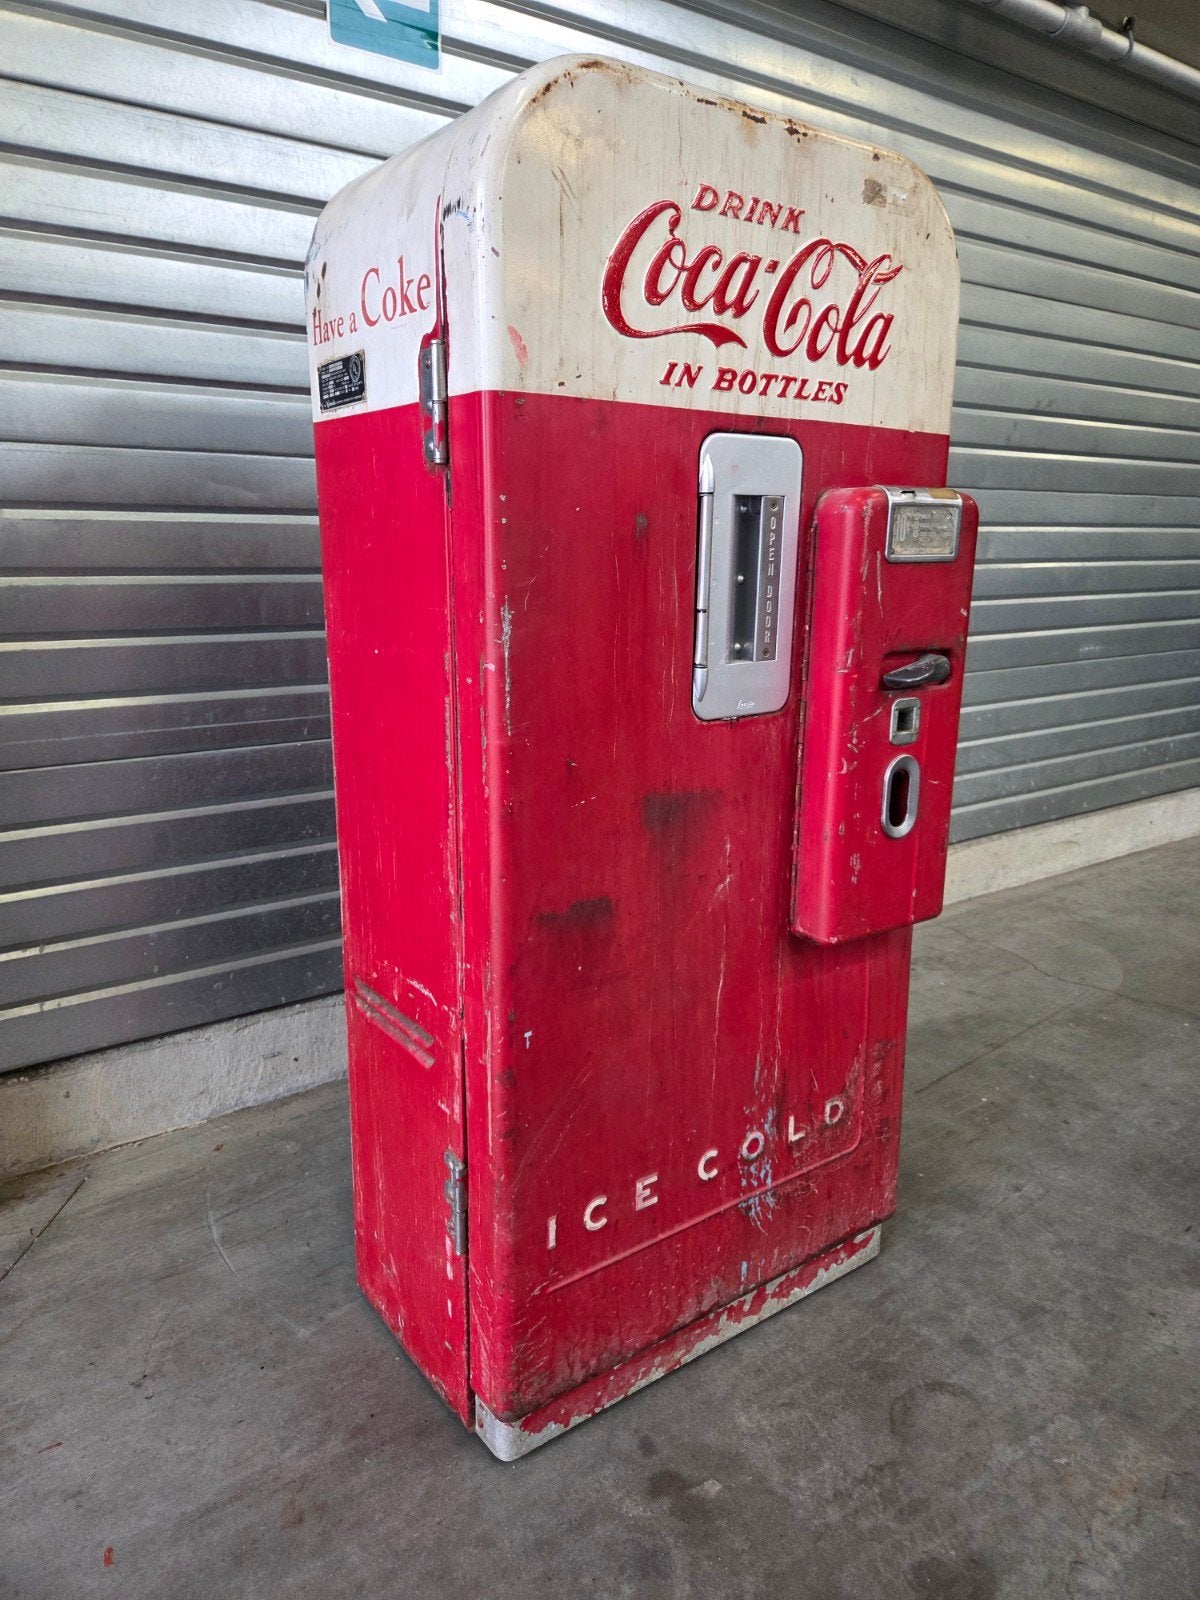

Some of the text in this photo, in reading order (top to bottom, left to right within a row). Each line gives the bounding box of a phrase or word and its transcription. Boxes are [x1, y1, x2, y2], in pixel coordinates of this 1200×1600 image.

[690, 182, 805, 234] DRINK
[312, 254, 431, 346] Have a Coke
[601, 199, 903, 371] Coca-Cola
[659, 361, 848, 405] IN BOTTLES
[764, 516, 777, 643] OPEN DOOR
[547, 1098, 844, 1249] ICE COLD
